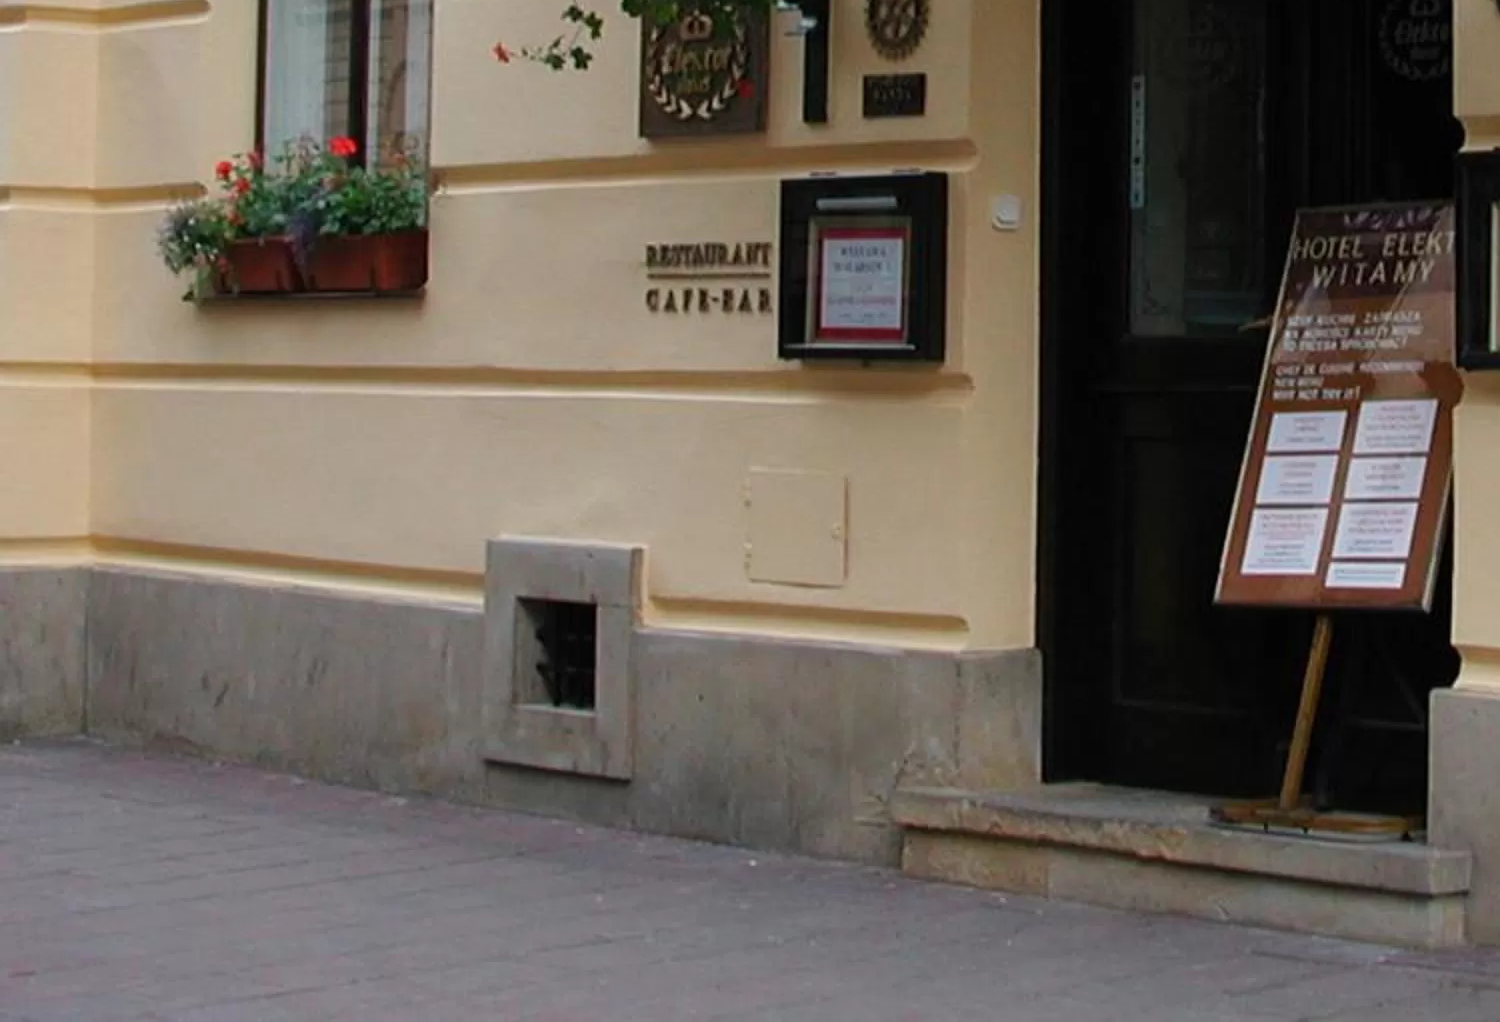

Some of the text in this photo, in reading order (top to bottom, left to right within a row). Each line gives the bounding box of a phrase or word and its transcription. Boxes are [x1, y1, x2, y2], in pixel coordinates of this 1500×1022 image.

[645, 241, 772, 268] RESTAURANT
[1294, 230, 1455, 259] HOTEL ELEKT
[1313, 259, 1435, 288] WITAMY
[645, 286, 773, 314] CAFE-BAR
